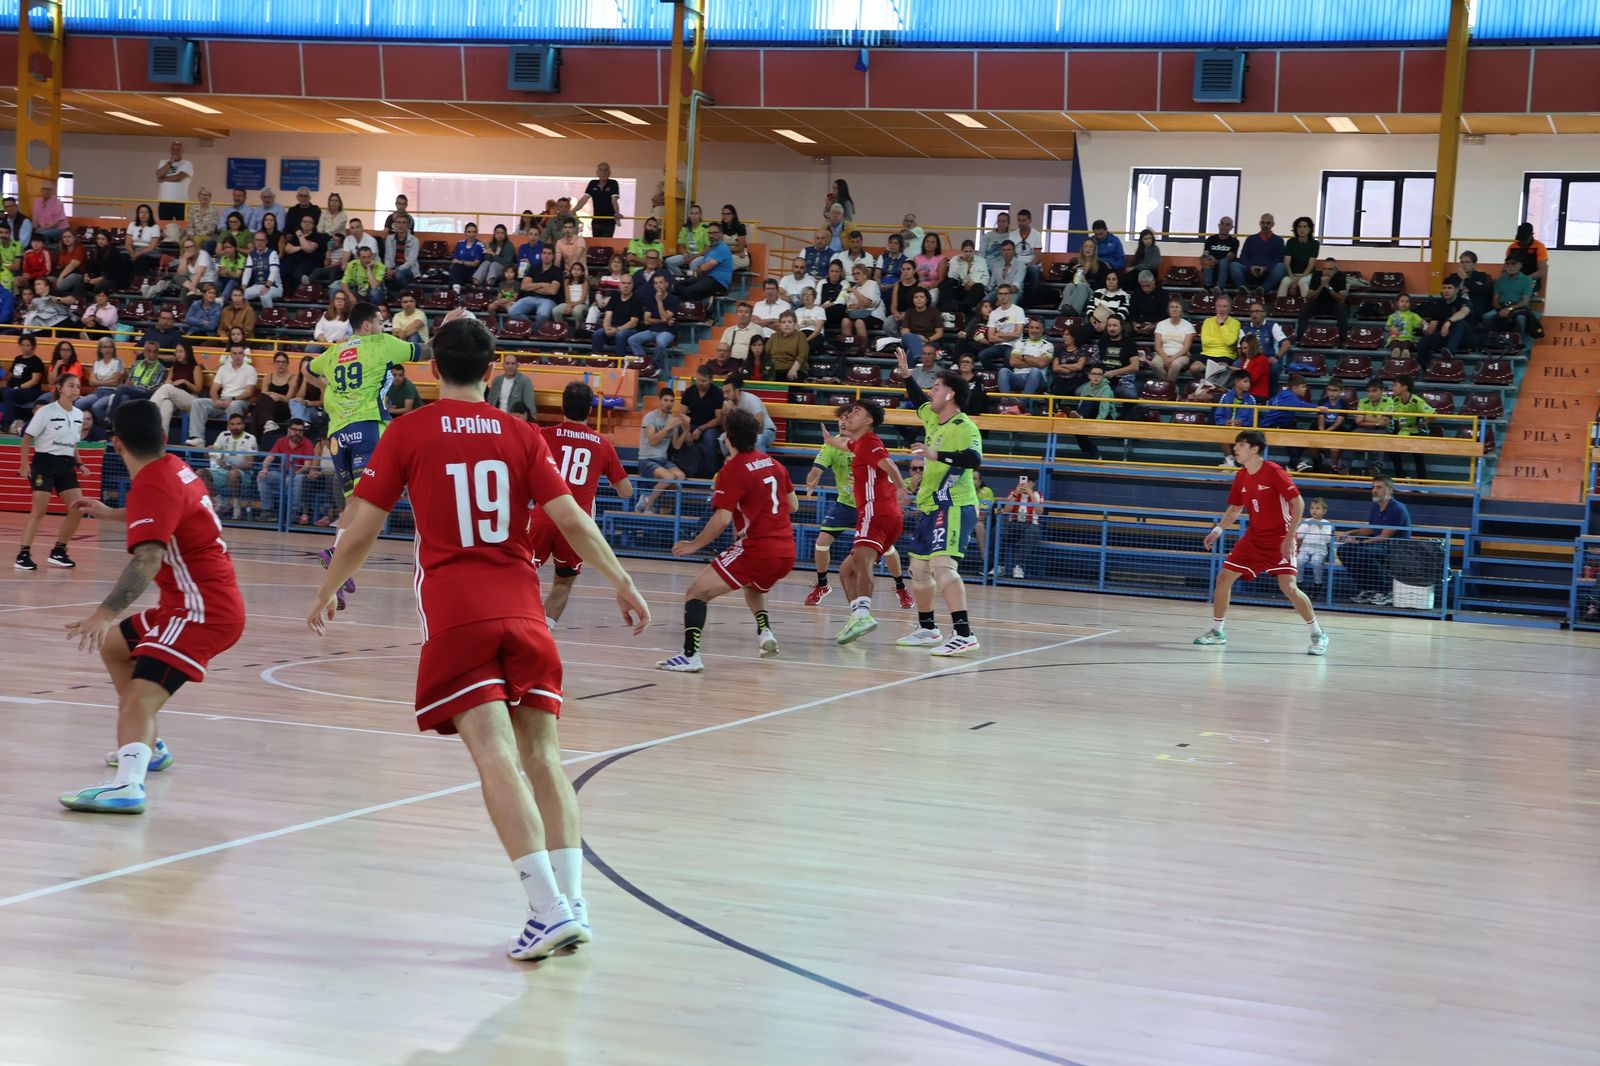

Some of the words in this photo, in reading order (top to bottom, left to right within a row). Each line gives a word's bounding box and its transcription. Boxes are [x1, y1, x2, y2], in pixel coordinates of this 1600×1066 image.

[1560, 322, 1591, 333] FILA
[1553, 336, 1585, 347] FILA
[334, 361, 363, 392] 99
[1543, 366, 1577, 378] FILA
[1533, 397, 1568, 410] FILA
[441, 415, 502, 435] A.PAÍNO
[1523, 430, 1559, 443] FILA
[559, 445, 592, 486] 18
[1514, 465, 1549, 478] FILA
[763, 475, 780, 515] 7
[445, 459, 510, 548] 19
[932, 527, 946, 544] 32
